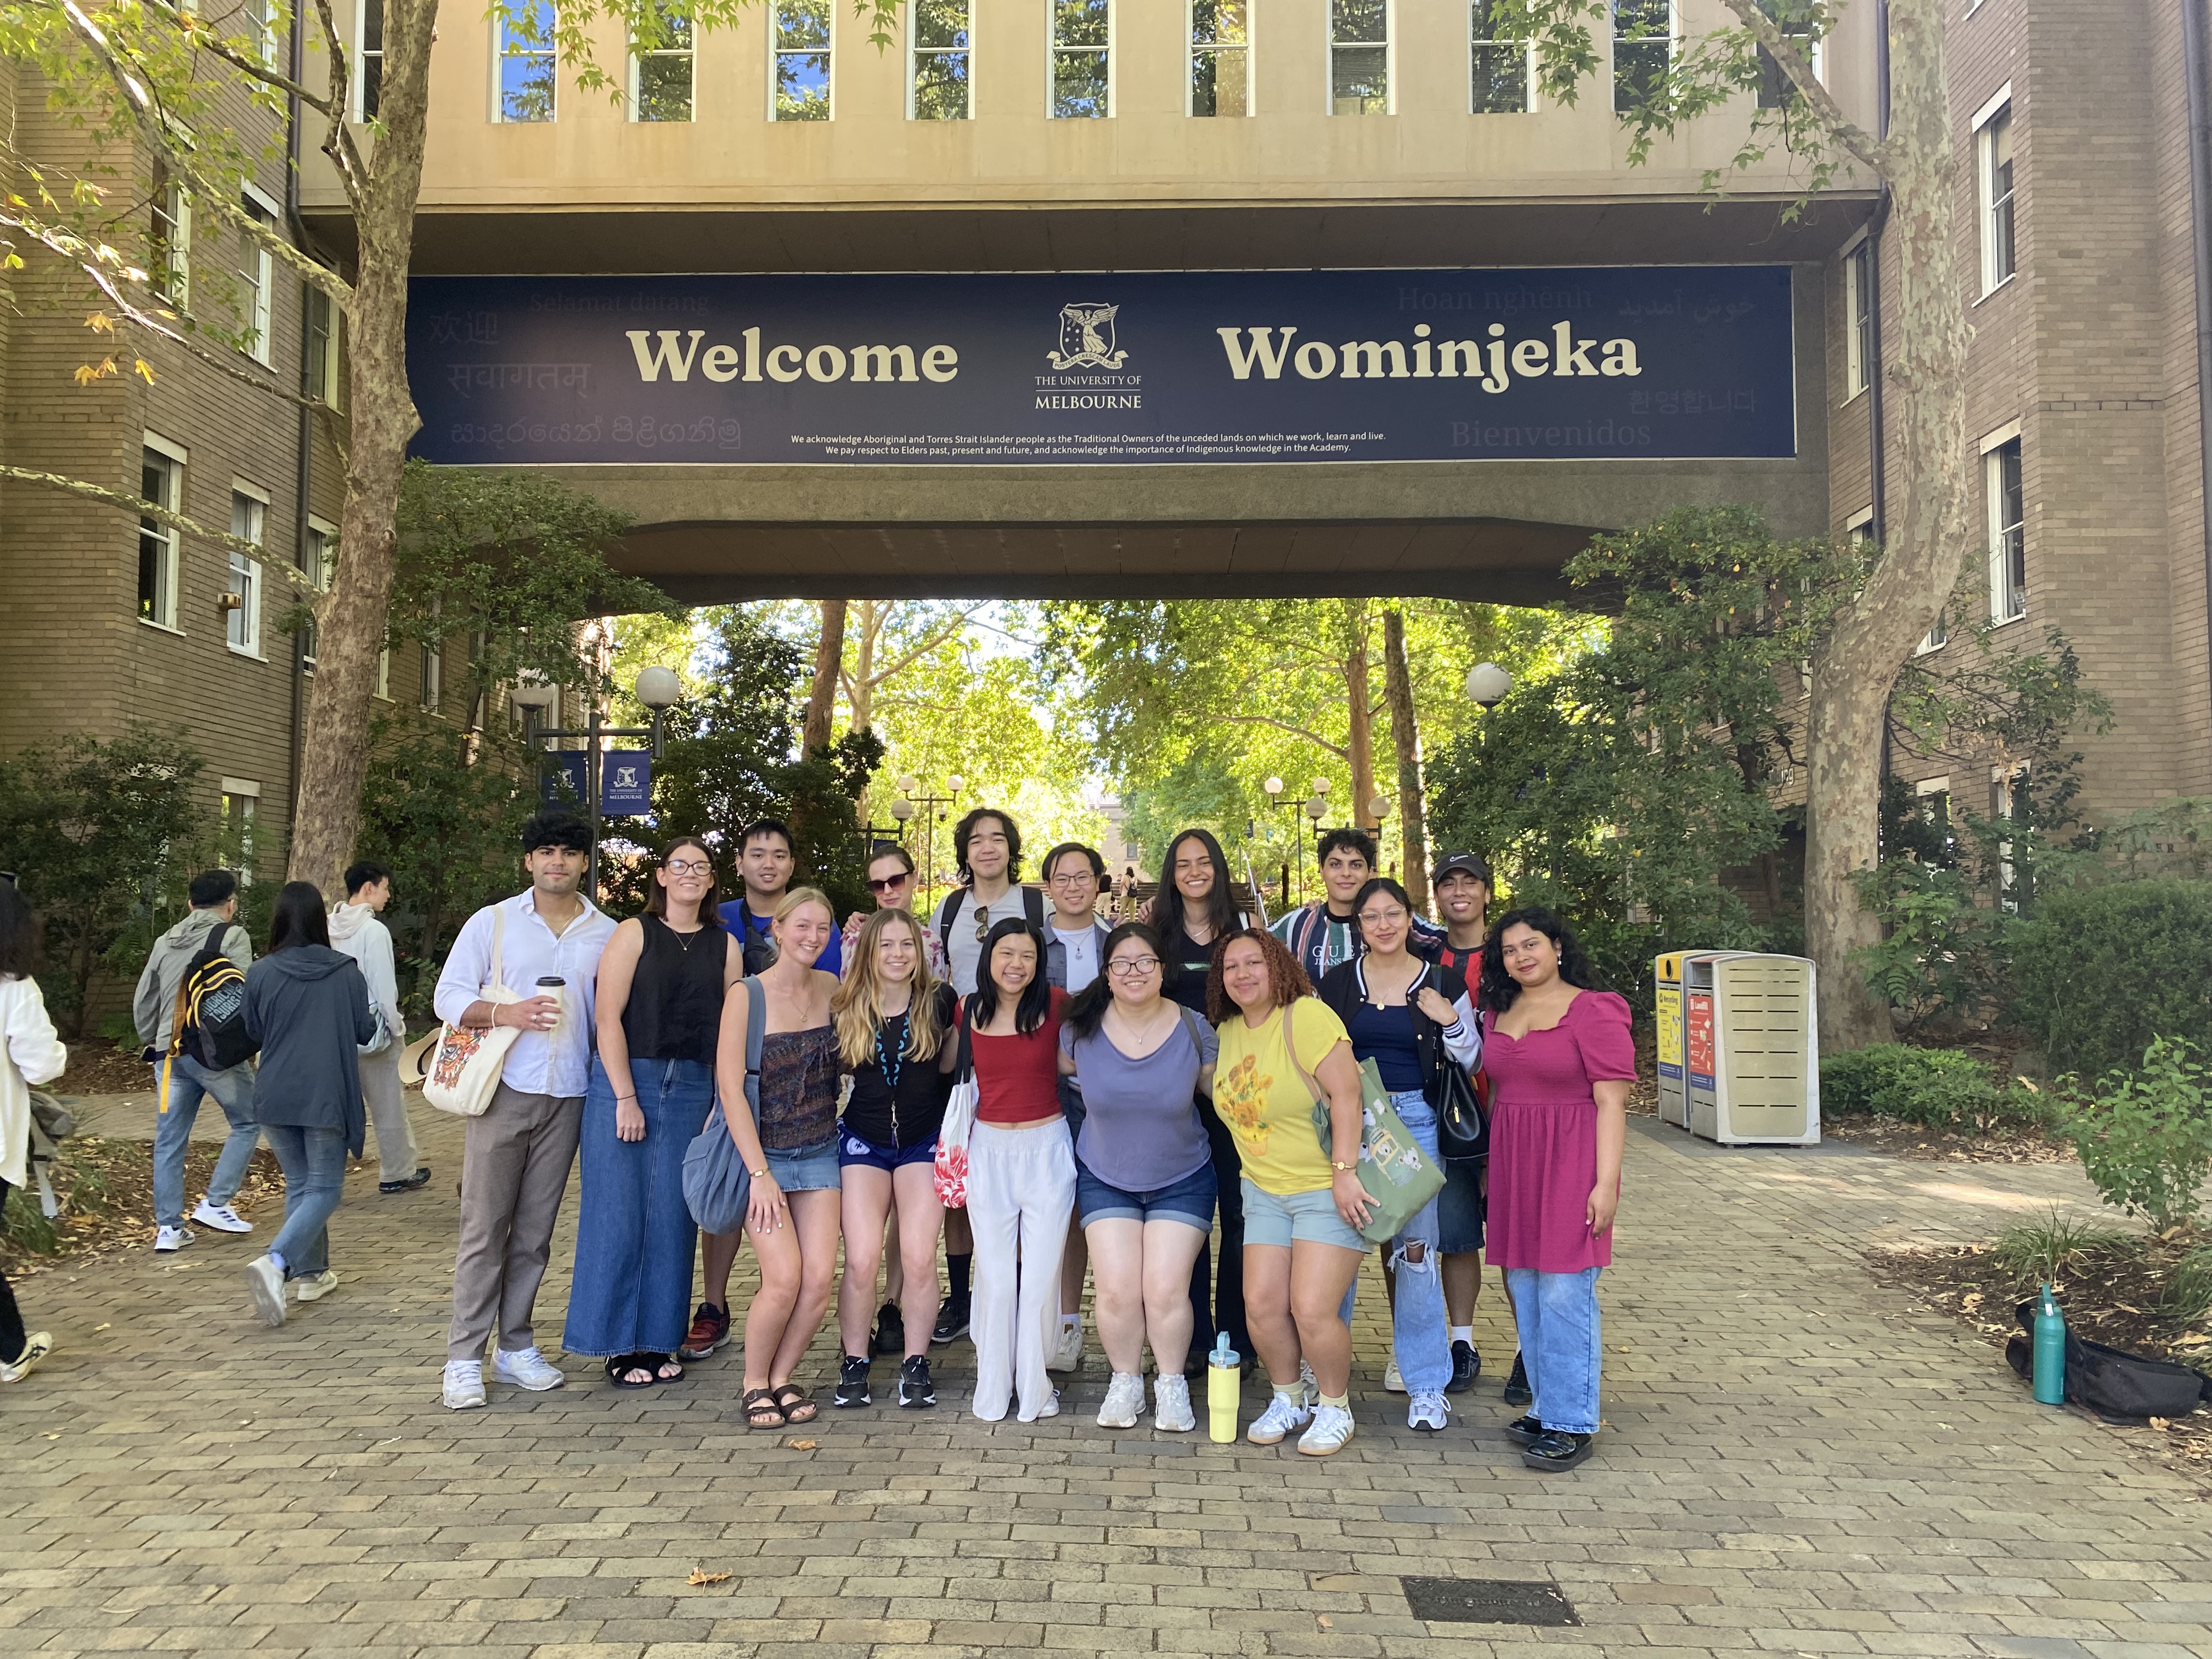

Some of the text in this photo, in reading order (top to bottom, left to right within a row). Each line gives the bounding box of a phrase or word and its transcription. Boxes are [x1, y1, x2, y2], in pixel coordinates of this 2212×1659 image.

[531, 291, 709, 317] Selamat datang
[1397, 286, 1474, 311] Hoan
[429, 311, 499, 345] 欢迎
[625, 326, 958, 383] Welcome
[1054, 353, 1121, 369] POSTERA CRESCAM LAUDE
[1216, 320, 1643, 394] Wominjeka
[1035, 375, 1142, 386] THE UNIVERSITY OF
[1035, 395, 1142, 409] MELBOURNE
[1628, 387, 1758, 415] 환영합니다
[791, 435, 804, 443] We
[806, 435, 862, 445] acknowledge
[863, 434, 907, 445] Aboriginal
[909, 435, 924, 444] and
[927, 435, 953, 443] Torres
[955, 435, 978, 443] Strait
[980, 435, 1014, 443] Islander
[1015, 435, 1045, 444] people
[1058, 435, 1072, 443] the
[1074, 435, 1120, 443] Traditional
[1121, 434, 1154, 443] Owners
[1155, 433, 1165, 443] of
[1166, 434, 1180, 442] the
[1182, 433, 1218, 442] unceded
[1221, 433, 1244, 442] lands
[1259, 432, 1284, 441] which
[1300, 432, 1324, 442] work,
[1326, 432, 1348, 441] learn
[1350, 431, 1367, 440] and
[1368, 431, 1386, 440] live.
[1449, 417, 1652, 447] Bienvenidos
[825, 443, 1351, 456] We pay respect to Elders past, present and future, and acknowledge the importance of Indigenous knowledge in the Academy.
